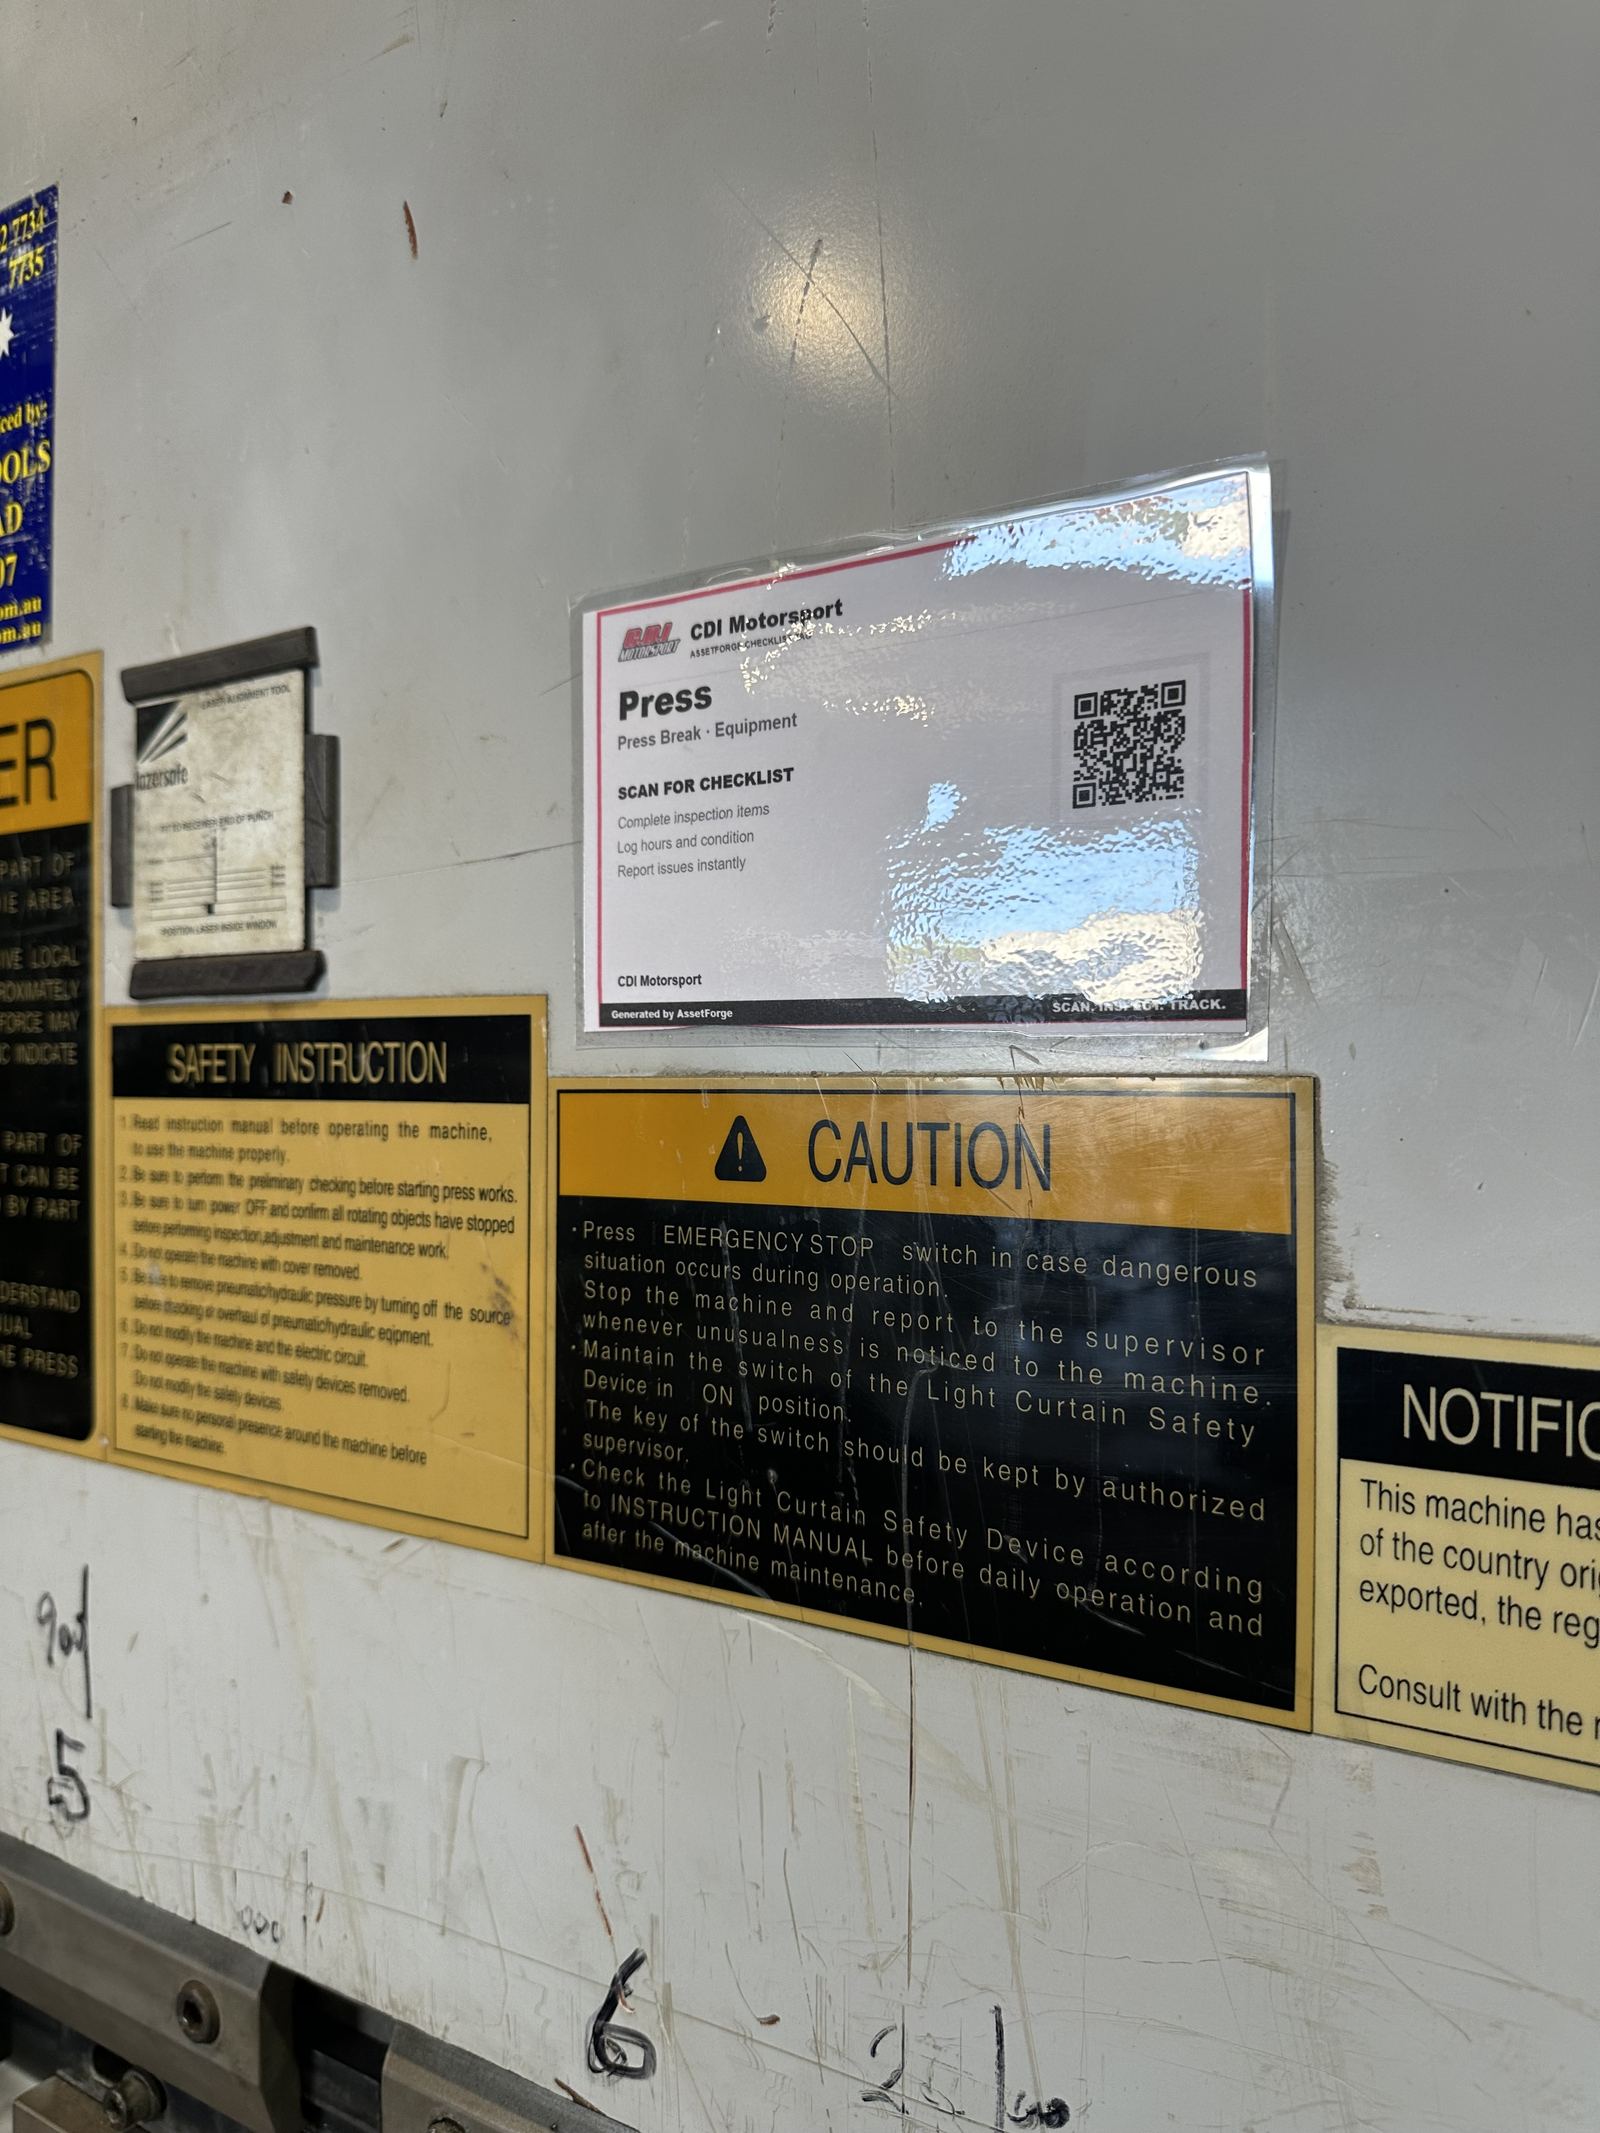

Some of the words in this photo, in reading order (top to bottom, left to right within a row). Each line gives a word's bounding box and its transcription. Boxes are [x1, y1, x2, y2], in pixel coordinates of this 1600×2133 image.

[0, 439, 51, 485] OLS
[690, 618, 722, 641] CDI
[729, 598, 843, 635] Motorsport
[618, 686, 713, 721] Press
[617, 734, 656, 750] Press
[660, 725, 701, 745] Break
[714, 712, 798, 741] Equipment
[617, 783, 659, 800] SCAN
[663, 778, 695, 796] FOR
[699, 767, 795, 792] CHECKLIST
[617, 814, 671, 830] Complete
[673, 807, 733, 827] inspection
[737, 803, 770, 819] items
[617, 841, 638, 856] Log
[640, 838, 673, 853] hours
[675, 834, 697, 849] and
[700, 830, 754, 848] condition
[617, 864, 655, 880] Report
[657, 859, 694, 875] issues
[697, 856, 746, 873] instantly
[617, 975, 637, 988] CDI
[640, 973, 702, 989] Motorsport
[611, 1009, 661, 1020] Generated
[663, 1009, 675, 1021] by
[677, 1008, 733, 1020] AssetForge
[1052, 1001, 1095, 1013] SCAN.
[1169, 998, 1227, 1011] TRACK.
[167, 1042, 256, 1085] SAFETY
[273, 1040, 448, 1085] INSTRUCTION
[280, 1118, 320, 1135] before
[328, 1119, 389, 1142] operating
[398, 1120, 420, 1139] the
[430, 1122, 492, 1143] machine,
[808, 1118, 1051, 1191] CAUTION
[359, 1178, 394, 1196] before
[397, 1180, 440, 1204] starting
[443, 1185, 475, 1202] press
[479, 1184, 518, 1204] works.
[391, 1208, 431, 1230] objects
[435, 1212, 463, 1231] have
[467, 1214, 515, 1237] stopped
[344, 1234, 415, 1255] maintenance
[418, 1240, 449, 1260] work.
[582, 1220, 636, 1242] Press
[663, 1224, 802, 1254] EMERGENCY
[809, 1233, 875, 1257] STOP
[902, 1242, 978, 1266] switch
[991, 1244, 1012, 1268] in
[1026, 1250, 1088, 1274] case
[1102, 1254, 1258, 1288] dangerous
[584, 1251, 666, 1275] situation
[675, 1258, 741, 1280] occurs
[752, 1263, 819, 1292] during
[830, 1275, 948, 1299] operation.
[381, 1296, 420, 1321] turning
[423, 1298, 438, 1318] off
[444, 1301, 463, 1320] the
[470, 1307, 511, 1326] source
[584, 1279, 632, 1305] Stop
[646, 1284, 680, 1306] the
[695, 1291, 793, 1318] machine
[809, 1302, 853, 1324] and
[872, 1308, 954, 1334] report
[973, 1314, 998, 1338] to
[1019, 1319, 1064, 1344] the
[1085, 1327, 1265, 1367] supervisor
[22, 1347, 79, 1378] PRESS
[582, 1312, 683, 1337] whenever
[696, 1325, 844, 1355] unusualness
[860, 1336, 880, 1360] is
[896, 1345, 995, 1374] noticed
[1013, 1355, 1039, 1378] to
[1057, 1360, 1103, 1385] the
[1123, 1370, 1272, 1406] machine.
[582, 1339, 675, 1368] Maintain
[689, 1350, 723, 1374] the
[738, 1359, 813, 1385] switch
[830, 1368, 852, 1389] of
[868, 1373, 909, 1397] the
[927, 1378, 996, 1409] Light
[1015, 1389, 1126, 1426] Curtain
[1148, 1406, 1255, 1448] Safety
[584, 1368, 647, 1394] Device
[656, 1376, 673, 1398] in
[702, 1383, 733, 1407] ON
[758, 1391, 852, 1424] position.
[342, 1436, 388, 1459] machine
[390, 1444, 428, 1466] before
[582, 1432, 690, 1464] supervisor.
[586, 1398, 622, 1422] The
[634, 1405, 668, 1432] key
[680, 1413, 698, 1433] of
[711, 1417, 745, 1440] the
[757, 1425, 829, 1454] switch
[844, 1438, 924, 1469] should
[938, 1450, 967, 1474] be
[983, 1455, 1039, 1489] kept
[1055, 1466, 1086, 1498] by
[1102, 1478, 1265, 1522] authorized
[1360, 1478, 1415, 1516] This
[1425, 1490, 1546, 1534] machine
[582, 1458, 645, 1488] Check
[658, 1471, 691, 1495] the
[706, 1478, 762, 1509] Light
[777, 1490, 866, 1528] Curtain
[884, 1509, 968, 1549] Safety
[987, 1527, 1085, 1566] Device
[1104, 1552, 1263, 1603] according
[582, 1519, 626, 1543] after
[635, 1528, 665, 1552] the
[674, 1539, 760, 1572] machine
[770, 1555, 923, 1606] maintenance.
[583, 1490, 601, 1511] to
[611, 1492, 761, 1541] INSTRUCTION
[773, 1521, 873, 1562] MANUAL
[886, 1543, 965, 1580] before
[979, 1562, 1041, 1597] daily
[1056, 1581, 1191, 1624] operation
[1208, 1609, 1263, 1638] and
[1360, 1526, 1384, 1557] of
[1392, 1531, 1434, 1566] the
[1443, 1543, 1549, 1591] country
[1560, 1557, 1600, 1600] ori
[1359, 1578, 1487, 1625] exported,
[1497, 1594, 1542, 1632] the
[1553, 1607, 1600, 1650] reg
[1359, 1663, 1462, 1714] Consult
[1470, 1686, 1527, 1726] with
[1537, 1698, 1583, 1737] the
